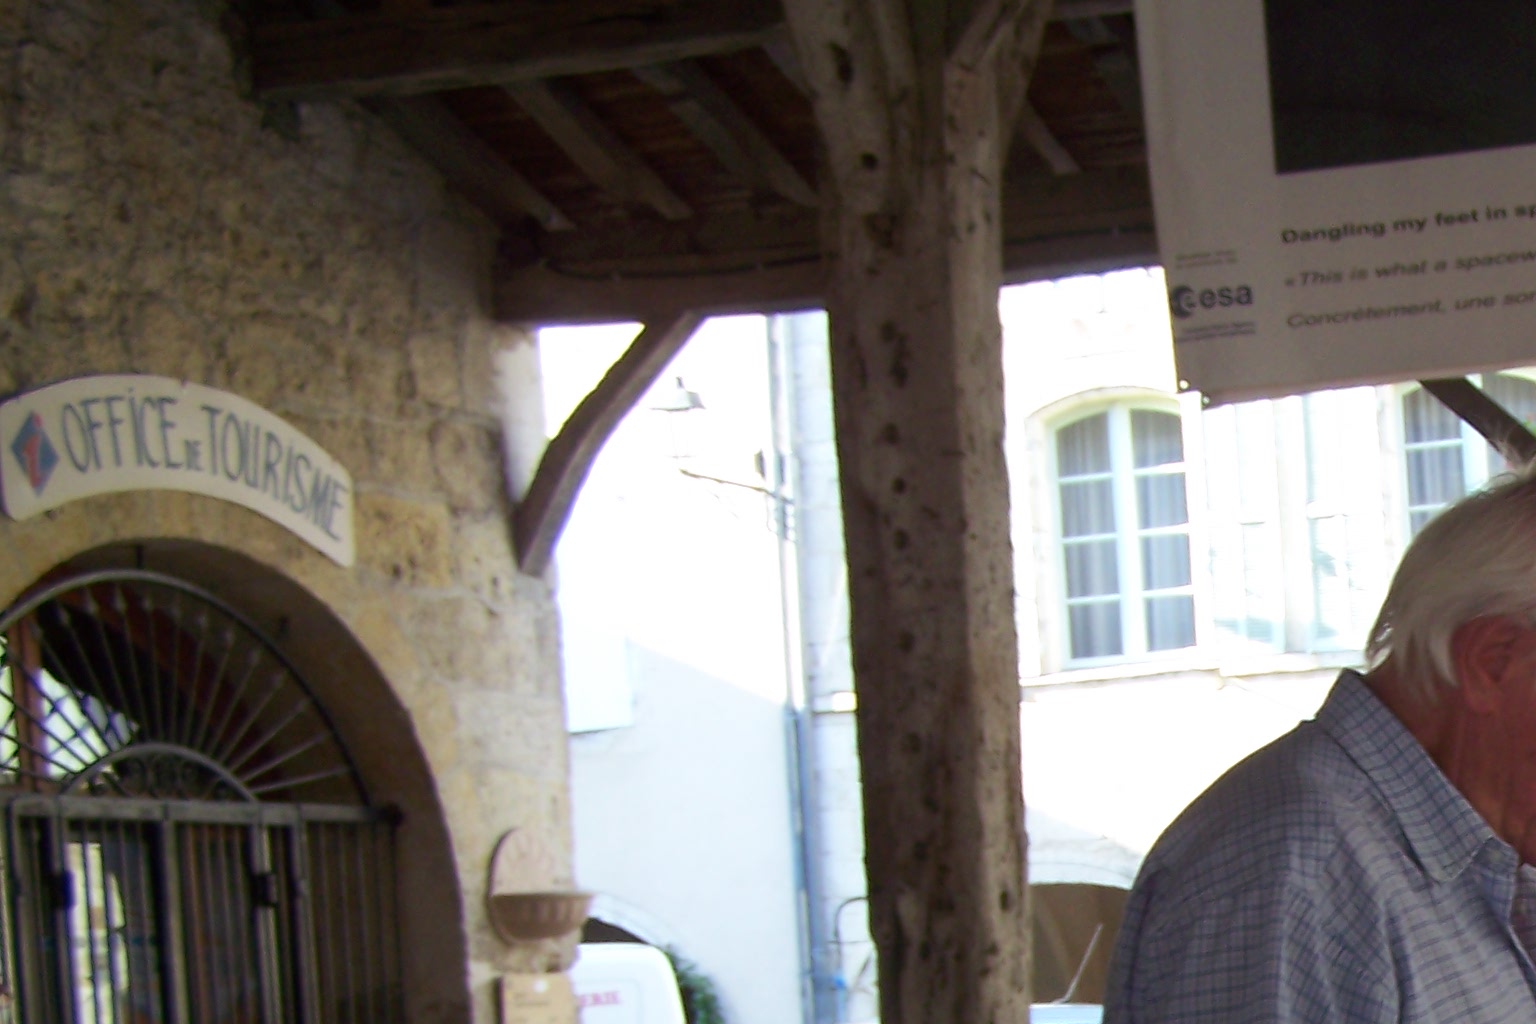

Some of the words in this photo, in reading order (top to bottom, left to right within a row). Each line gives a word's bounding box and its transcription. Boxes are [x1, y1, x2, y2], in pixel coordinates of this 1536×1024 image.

[1281, 222, 1386, 244] Dangling
[1393, 217, 1427, 232] my
[1435, 208, 1478, 226] feet
[1485, 205, 1507, 220] in
[1349, 265, 1368, 280] is
[1375, 259, 1427, 277] what
[1434, 259, 1447, 272] a
[1199, 284, 1253, 309] esa
[1455, 296, 1496, 310] une
[200, 404, 348, 543] TOURISME
